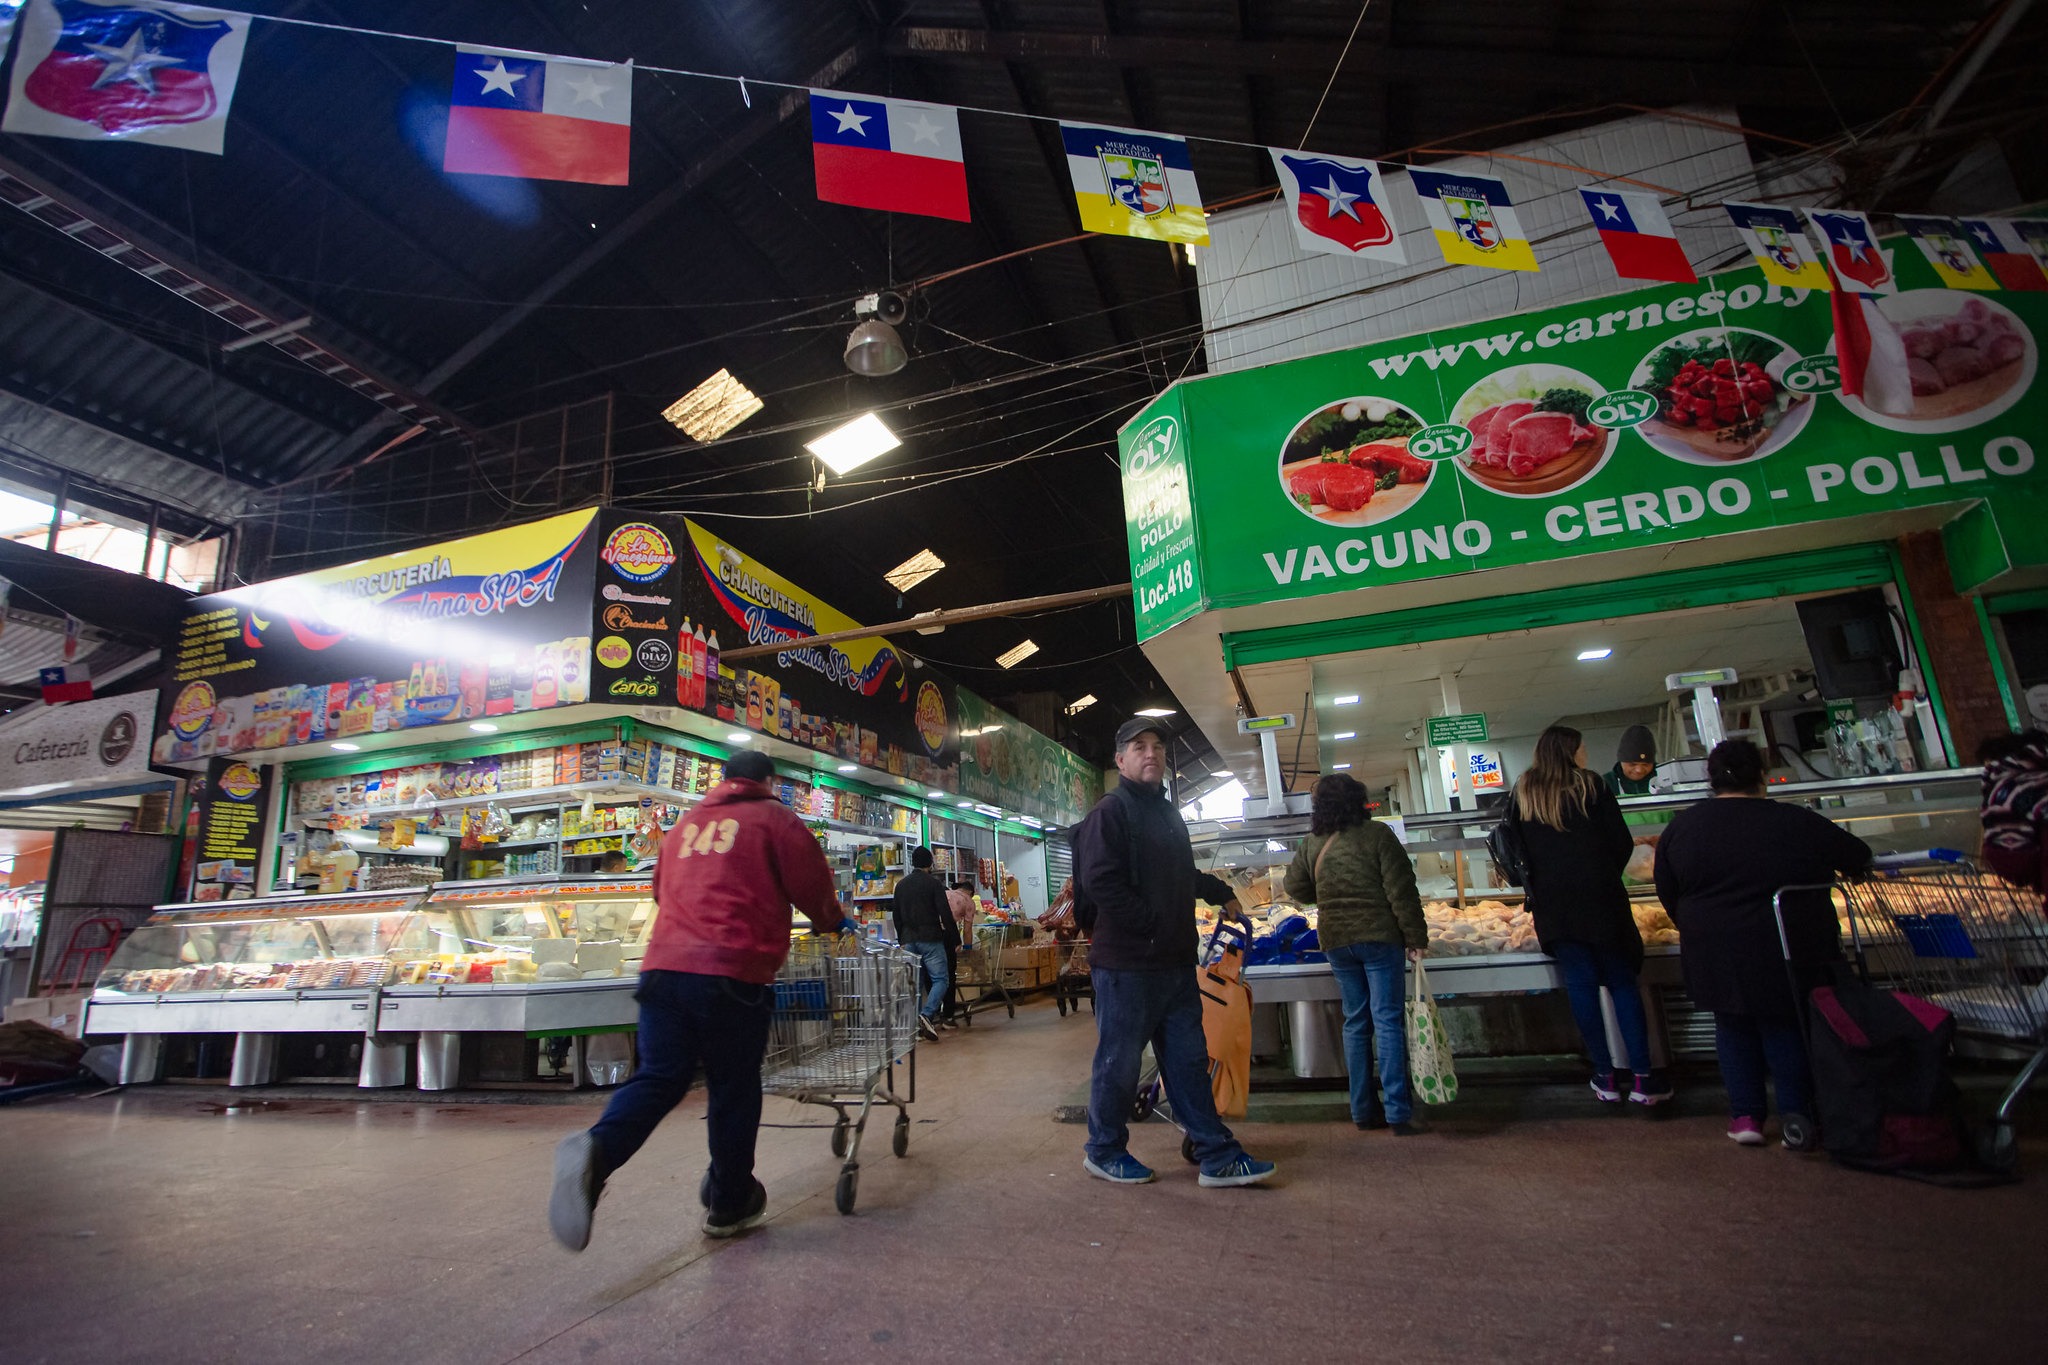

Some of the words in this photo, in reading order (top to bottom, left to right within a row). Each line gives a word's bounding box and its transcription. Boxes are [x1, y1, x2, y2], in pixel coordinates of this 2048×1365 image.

[1104, 147, 1155, 159] MATADERO
[1105, 141, 1150, 153] MERCADO
[1592, 399, 1651, 425] OLY
[1606, 394, 1635, 406] Carnes
[1129, 424, 1174, 479] OLY
[1412, 433, 1467, 457] OLY
[1138, 489, 1181, 531] CERDO
[1262, 520, 1493, 585] VACUNO
[1544, 477, 1752, 543] CERDO
[1805, 436, 2036, 502] POLLO
[627, 534, 651, 553] La
[1140, 511, 1182, 553] POLLO
[1135, 552, 1160, 579] Calidad
[1165, 533, 1194, 561] Frescura
[318, 555, 453, 599] HARCUTERÍA
[1141, 559, 1194, 614] Loc.418
[719, 562, 817, 630] CHARCUTERÍA
[610, 679, 658, 695] Canoa
[14, 735, 89, 765] Cafetería
[1470, 754, 1488, 765] SE
[678, 818, 740, 859] 243
